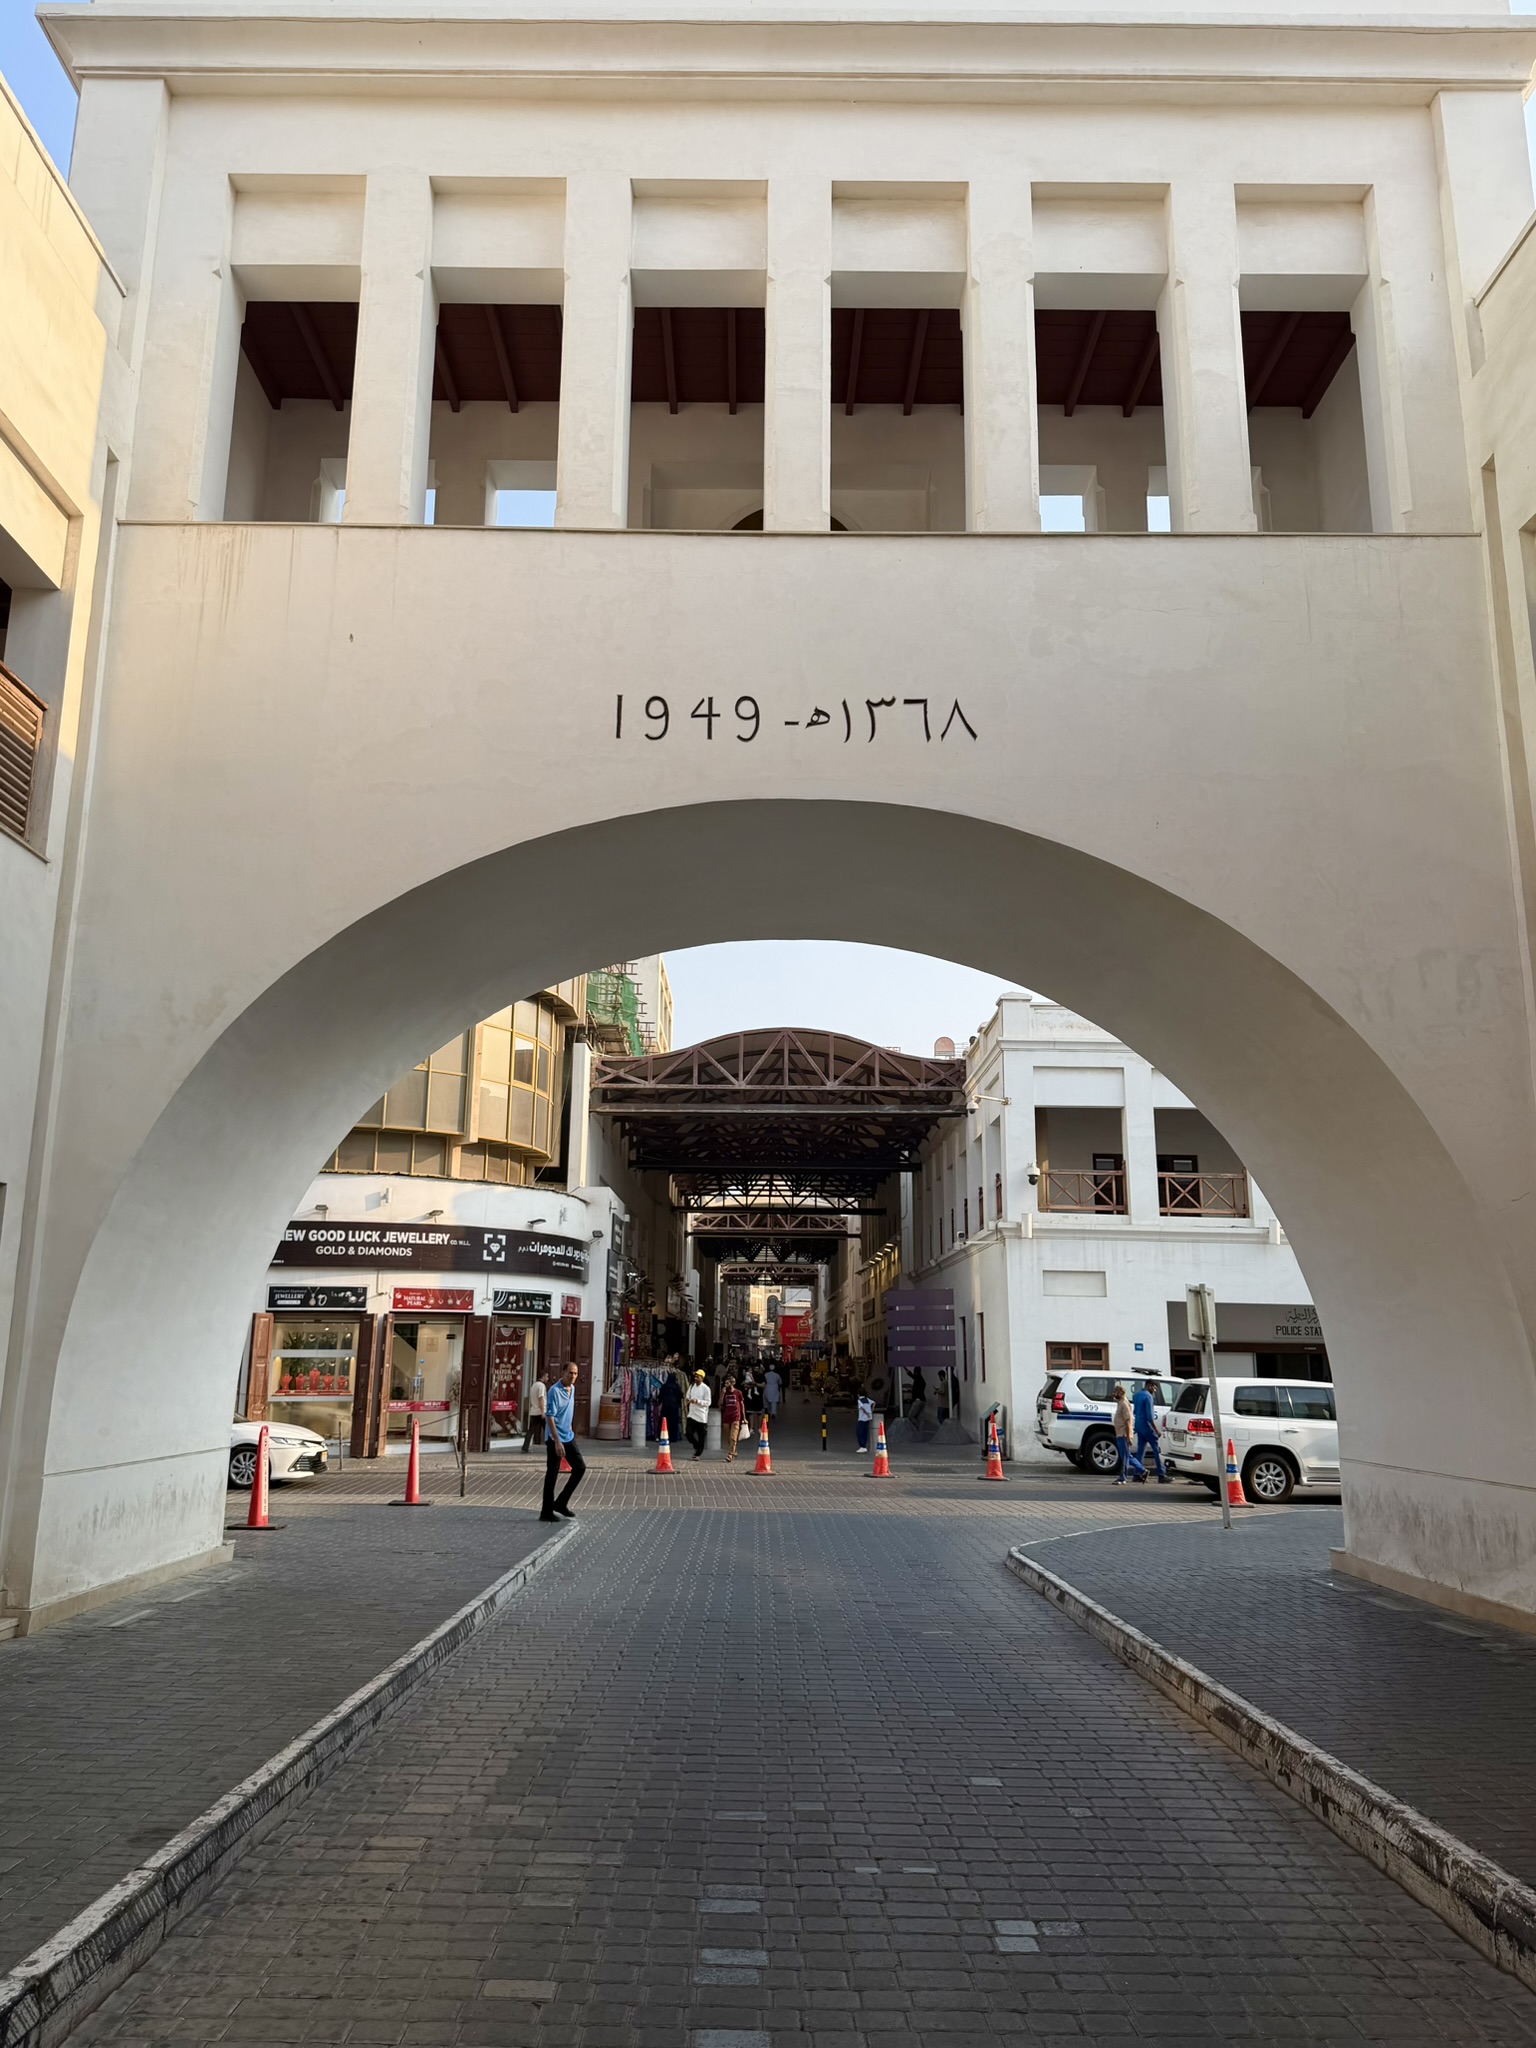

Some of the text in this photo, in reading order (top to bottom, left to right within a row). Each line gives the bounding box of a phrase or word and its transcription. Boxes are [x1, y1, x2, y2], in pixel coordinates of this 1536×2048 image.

[614, 693, 761, 743] 1949
[308, 1230, 346, 1243] GOOD
[348, 1231, 381, 1243] LUCK
[382, 1231, 450, 1246] JEWELLERY
[315, 1246, 413, 1257] GOLD & DIAMONDS
[1275, 1325, 1323, 1337] POLICE STAT
[1083, 1404, 1100, 1412] 999
